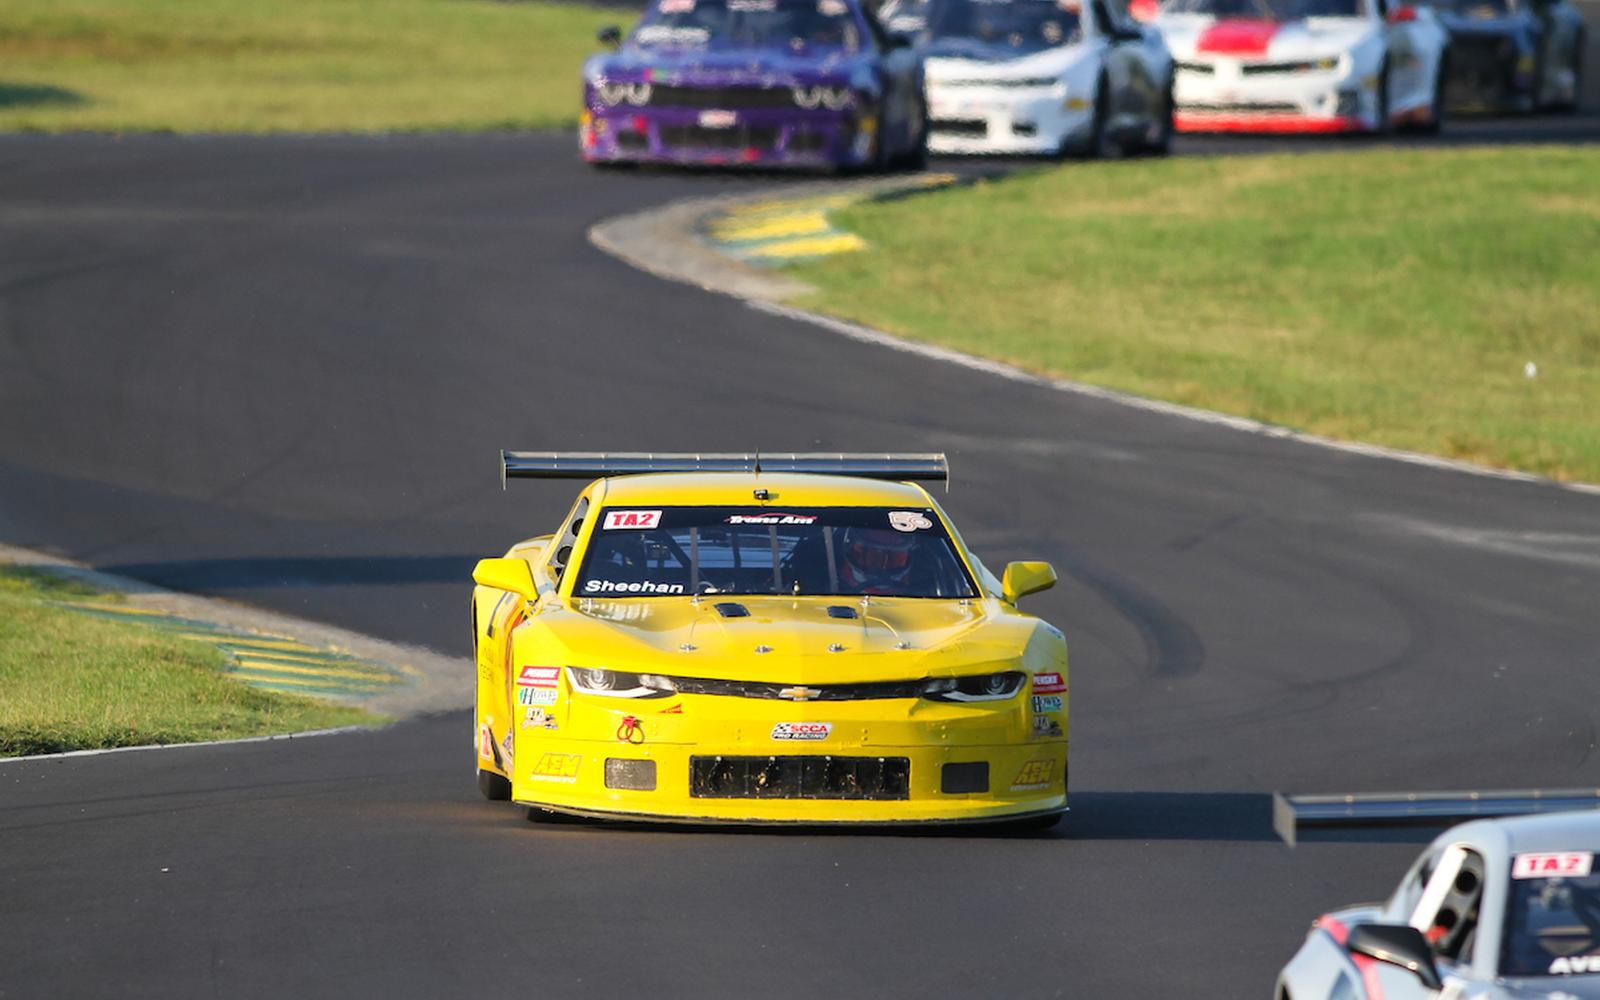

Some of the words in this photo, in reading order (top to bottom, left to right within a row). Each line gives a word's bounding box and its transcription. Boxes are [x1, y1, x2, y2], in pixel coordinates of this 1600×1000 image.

[613, 513, 654, 526] TA2
[730, 515, 779, 524] Trans
[779, 515, 814, 524] Am
[584, 580, 684, 594] Sheehan
[532, 753, 583, 777] AEM
[1528, 858, 1581, 871] TA2
